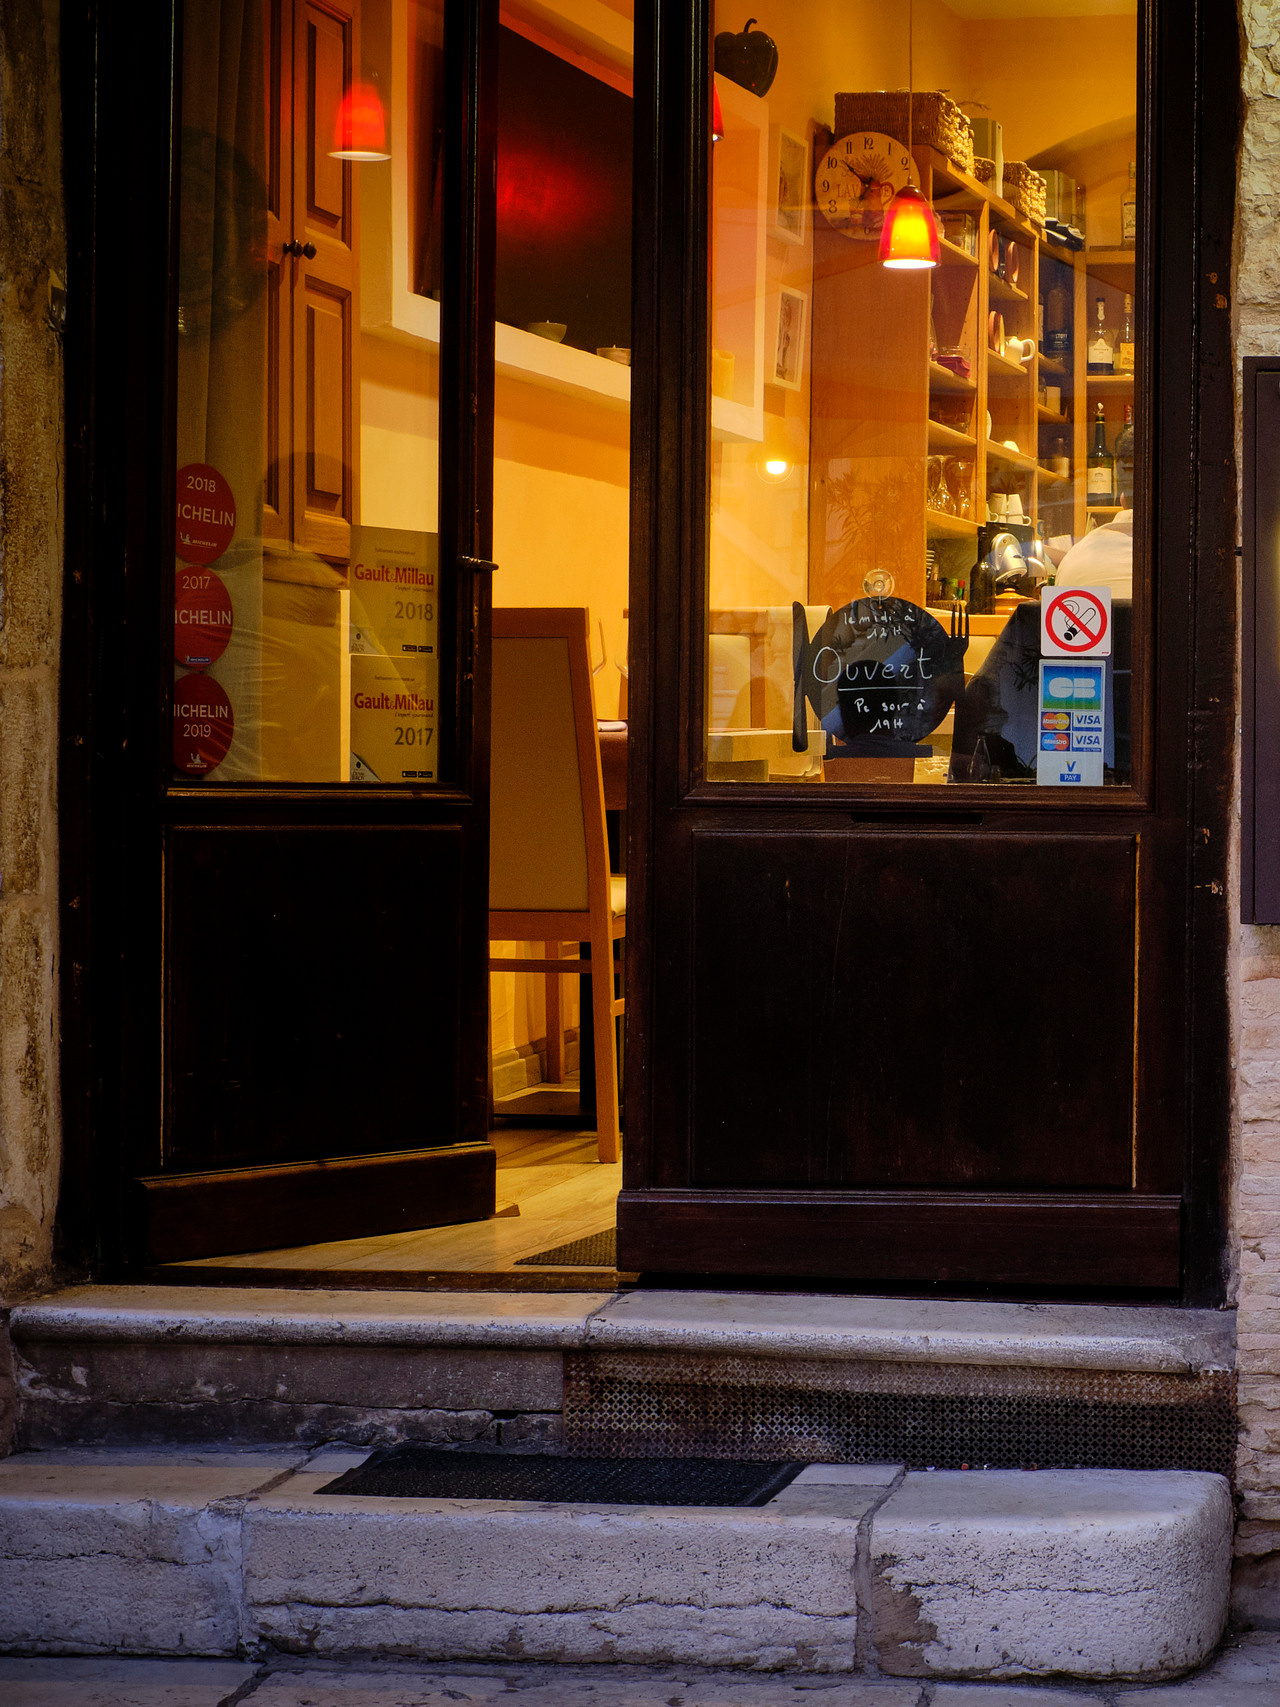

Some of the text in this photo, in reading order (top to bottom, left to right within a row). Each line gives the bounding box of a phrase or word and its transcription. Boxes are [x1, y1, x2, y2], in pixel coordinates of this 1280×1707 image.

[864, 137, 873, 150] 12
[826, 156, 838, 169] 10
[901, 157, 909, 170] 2
[822, 180, 830, 192] 9
[828, 200, 838, 214] 8
[187, 475, 217, 493] 2018
[176, 503, 235, 527] ICHELIN
[182, 576, 211, 590] 2017
[173, 610, 232, 625] ICHELIN
[395, 601, 434, 621] 2018
[813, 646, 933, 684] Ouvert
[882, 701, 909, 711] soir
[1075, 715, 1101, 725] VISA
[183, 724, 211, 738] 2019
[394, 727, 434, 746] 2017
[1075, 735, 1101, 745] VISA
[1065, 761, 1077, 772] V
